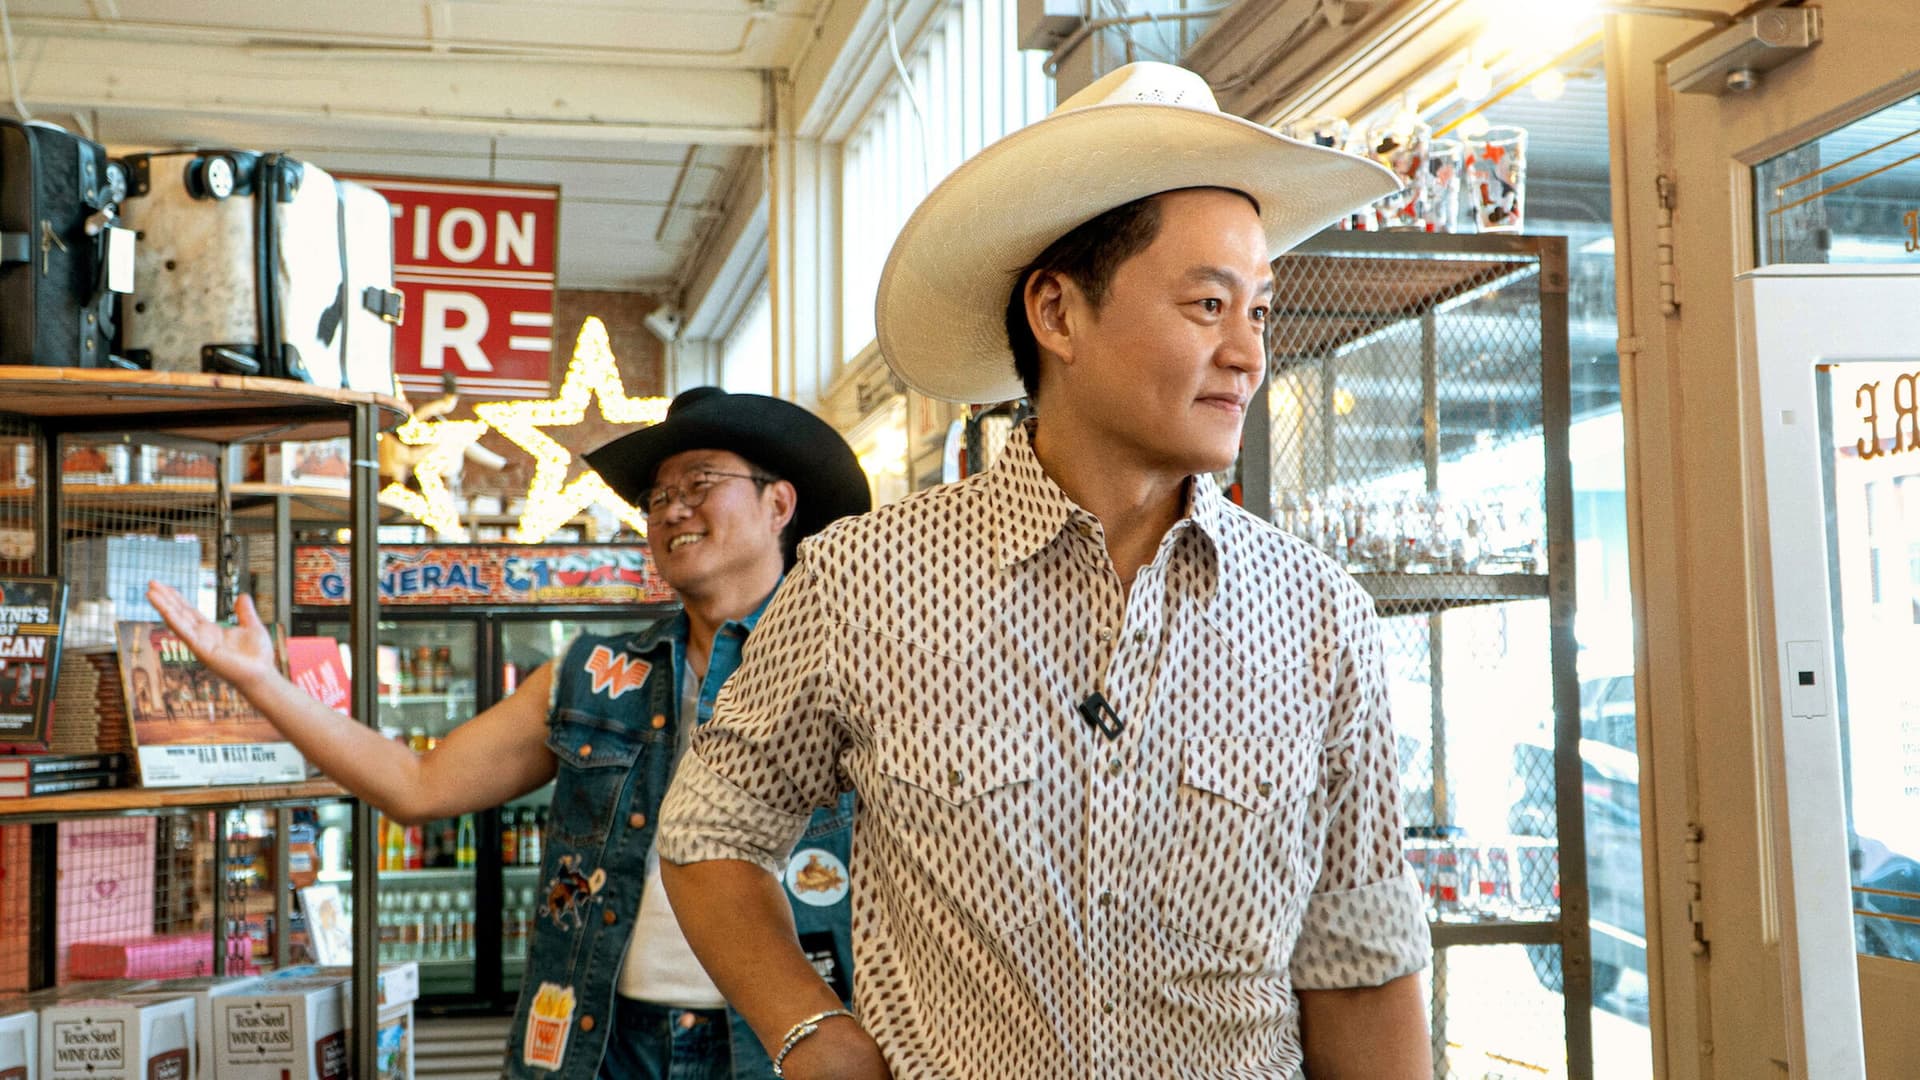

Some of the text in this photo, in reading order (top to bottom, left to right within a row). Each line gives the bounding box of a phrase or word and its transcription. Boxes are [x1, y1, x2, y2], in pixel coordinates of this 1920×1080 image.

[320, 563, 489, 597] GNERAL
[0, 635, 46, 658] CAN
[235, 1014, 260, 1028] Texas
[63, 1028, 117, 1045] Texas Sized
[231, 1031, 290, 1045] WINE GLASS
[58, 1047, 121, 1062] WINE GLASS
